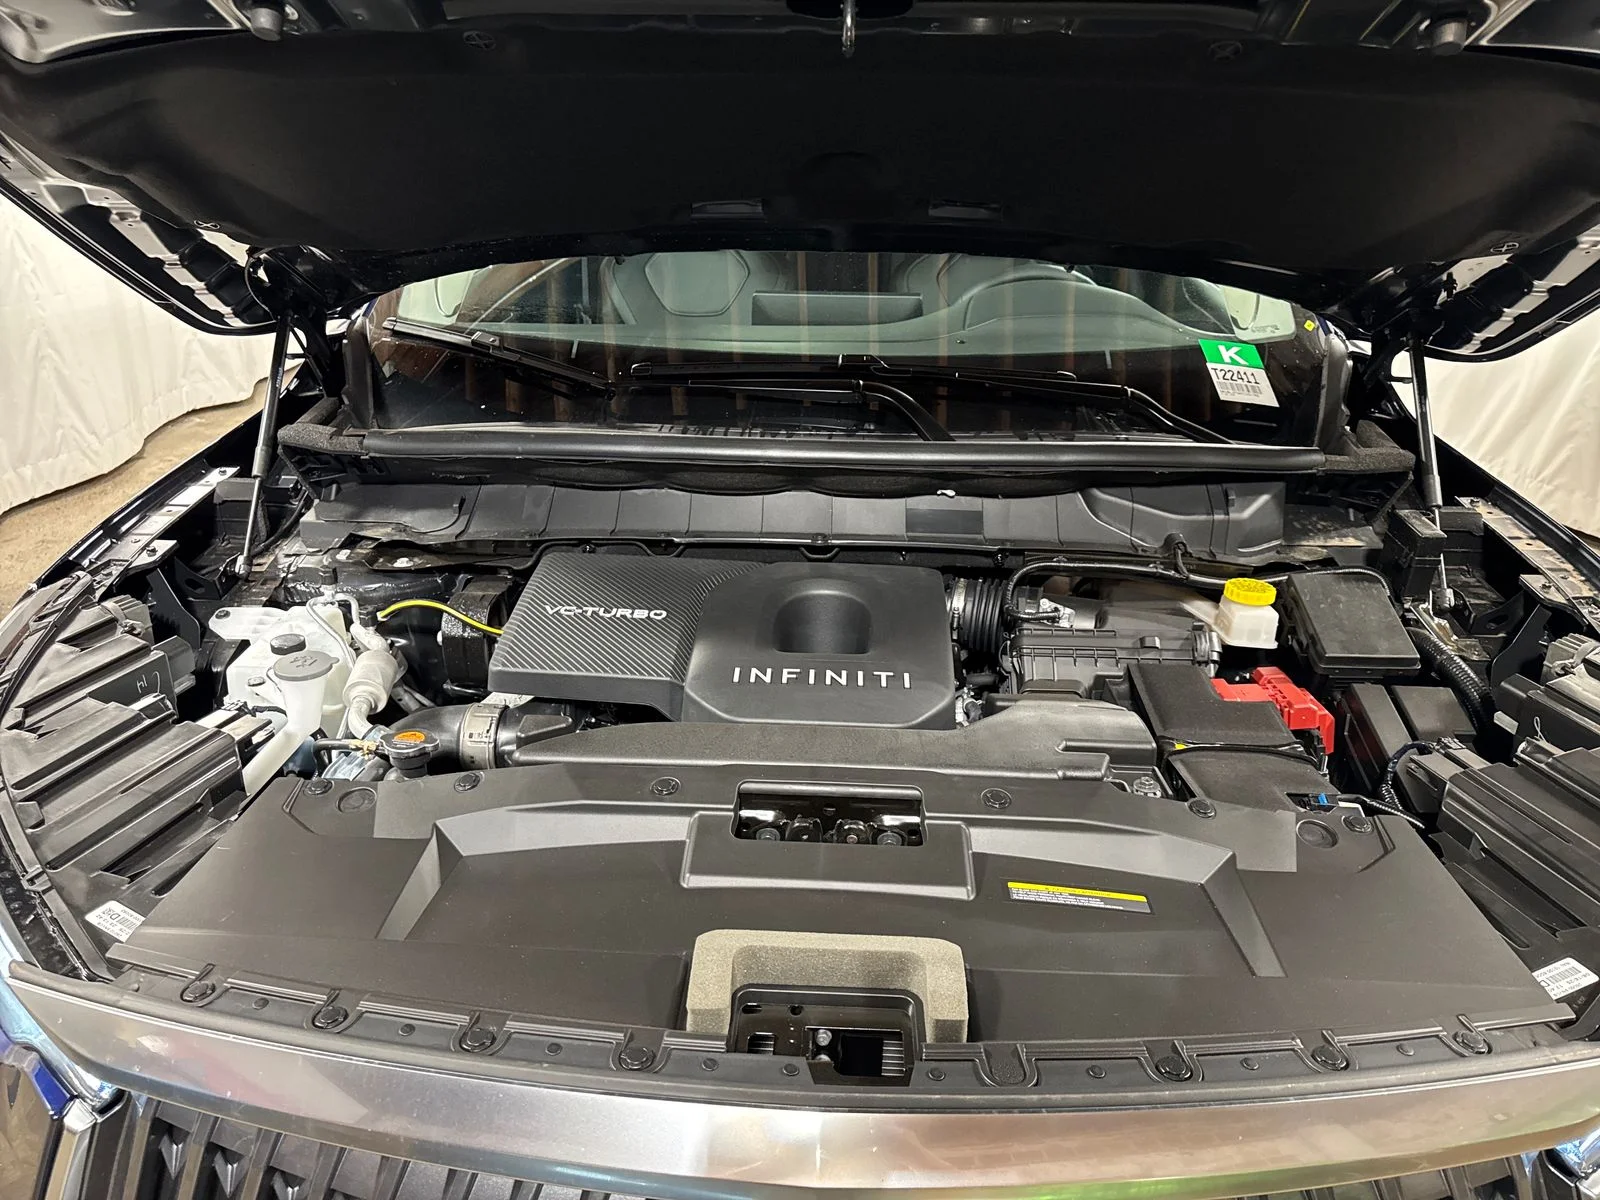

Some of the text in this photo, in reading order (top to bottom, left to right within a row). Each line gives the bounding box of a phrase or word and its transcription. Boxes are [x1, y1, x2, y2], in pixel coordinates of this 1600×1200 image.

[1217, 345, 1249, 365] K
[1211, 367, 1260, 384] T22411
[543, 604, 668, 621] VC-TURBO
[732, 666, 912, 690] INFINITI
